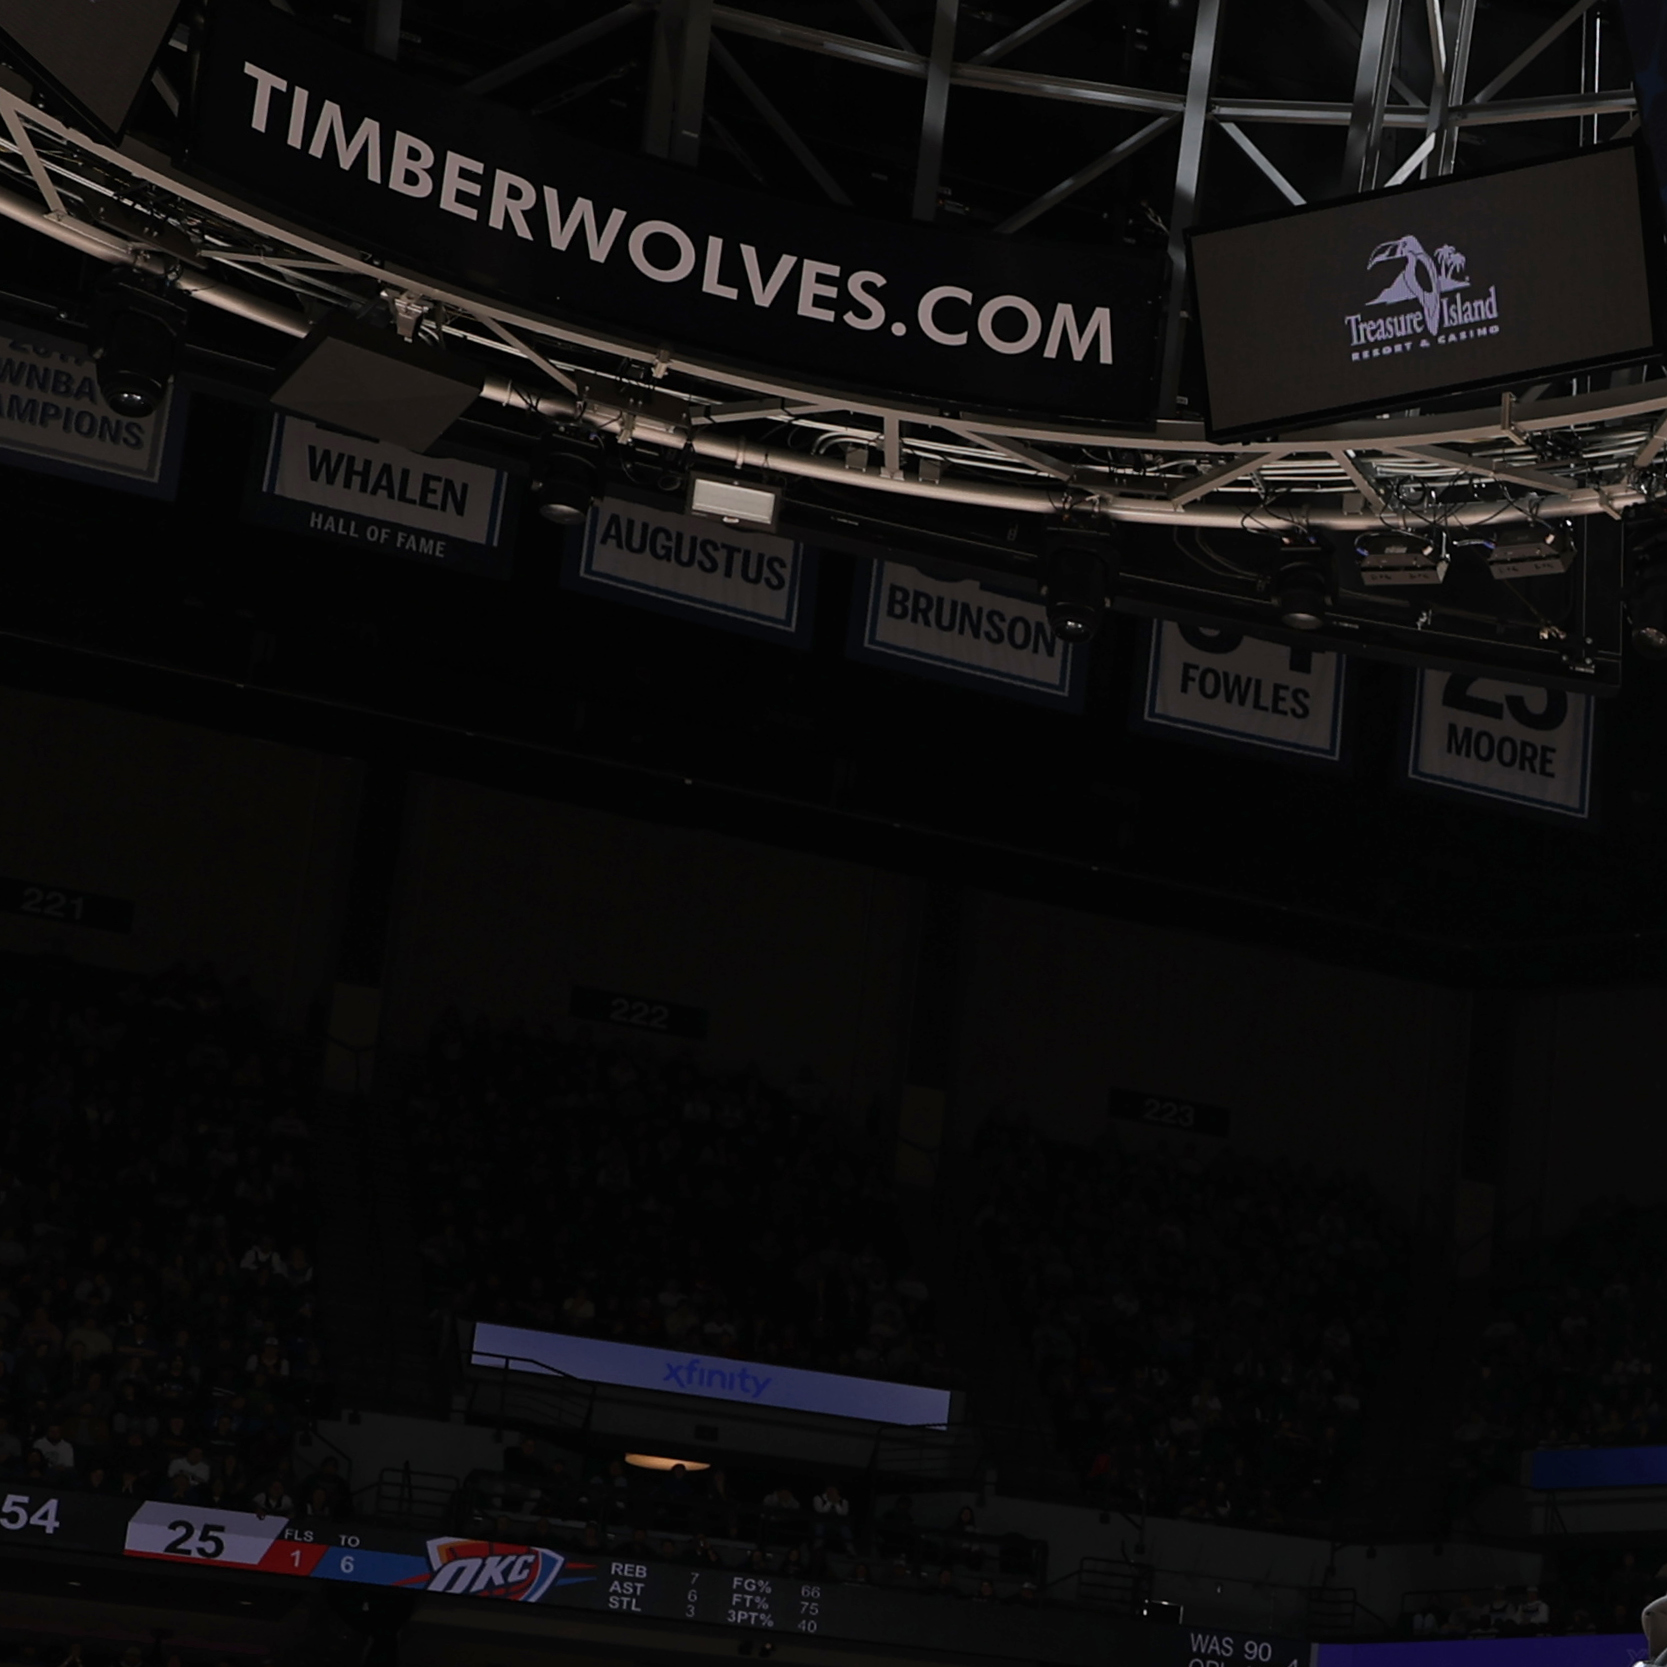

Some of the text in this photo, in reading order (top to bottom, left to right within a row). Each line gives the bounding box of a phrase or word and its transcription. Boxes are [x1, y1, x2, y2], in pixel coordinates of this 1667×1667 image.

[243, 61, 1114, 366] TIMBERWOLVES.COM
[1344, 284, 1500, 347] Treasure Island
[1351, 324, 1501, 361] RESORT & CASINO
[0, 356, 97, 402] WNBA
[307, 445, 469, 518] WHALEN
[309, 510, 447, 560] HALL OF FAME
[599, 512, 788, 592] AUGUSTUS
[886, 585, 1057, 660] BRUNSON
[1179, 663, 1312, 721] FOWLES
[1445, 723, 1557, 780] MOORE
[20, 887, 85, 921] 221
[609, 997, 670, 1032] 222
[1142, 1096, 1197, 1129] 223
[663, 1358, 772, 1400] xfinity
[0, 1494, 61, 1535] 54
[163, 1519, 227, 1559] 25
[284, 1527, 361, 1549] FLS TO
[290, 1549, 355, 1574] 1 6
[426, 1552, 538, 1594] OKC
[610, 1561, 822, 1599] REB 7 FG% 66
[607, 1595, 818, 1634] STL 3 3PT% 40
[608, 1580, 820, 1616] AST 6 FT% 75
[1189, 1632, 1273, 1663] WAS 90
